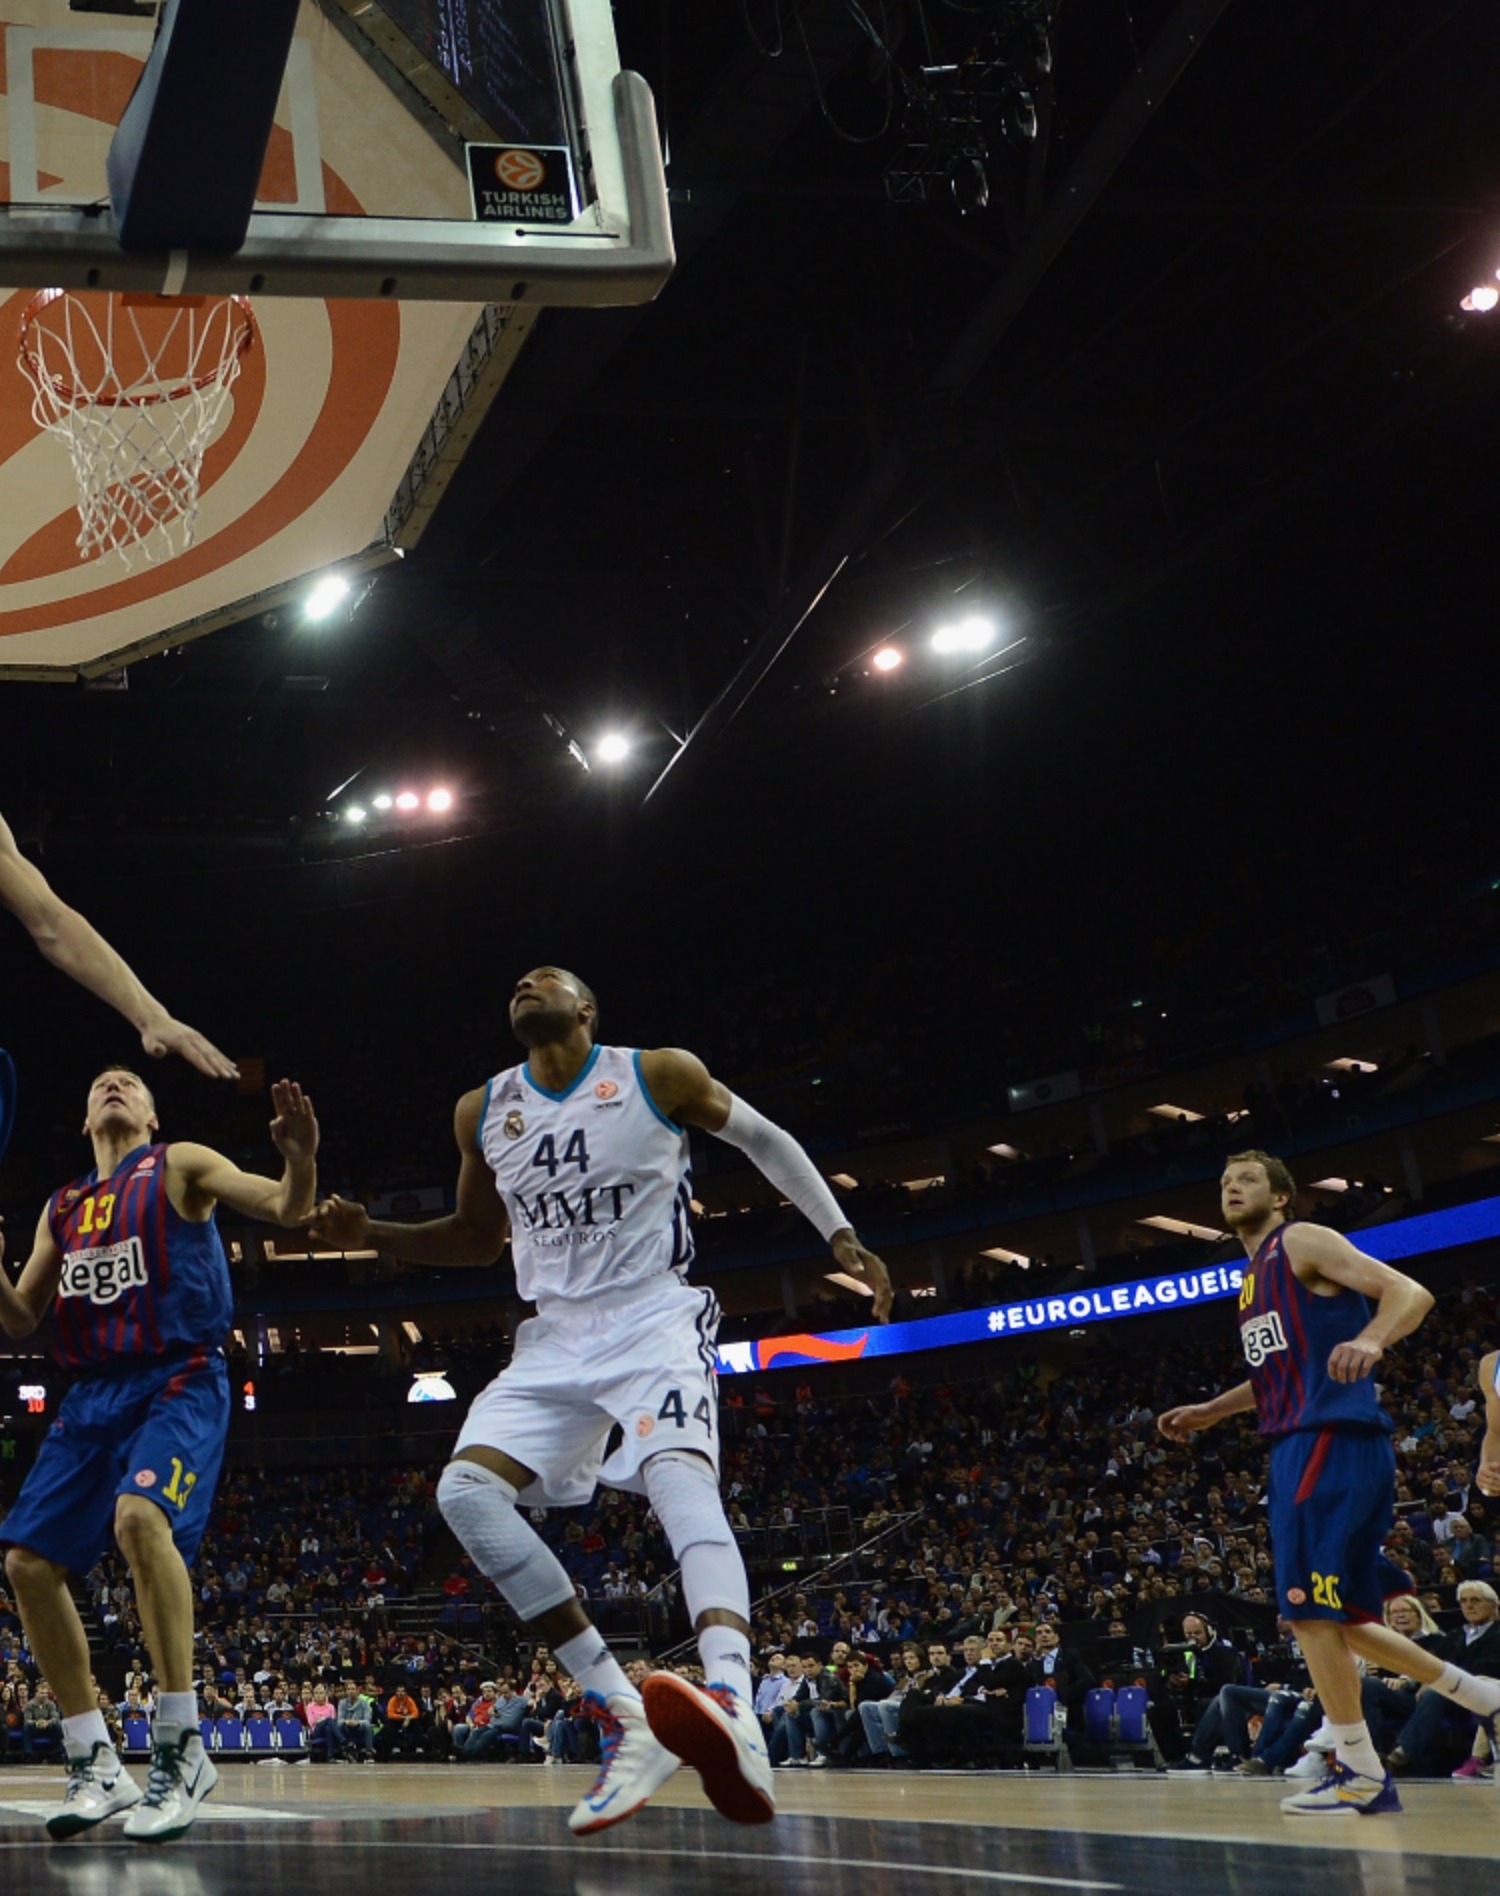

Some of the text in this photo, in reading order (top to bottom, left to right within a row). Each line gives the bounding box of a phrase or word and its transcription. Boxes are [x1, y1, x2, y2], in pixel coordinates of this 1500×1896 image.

[482, 191, 566, 206] TURKISH
[483, 204, 568, 220] AIRLINES
[533, 1128, 591, 1178] 44
[77, 1193, 116, 1235] 13
[513, 1183, 635, 1229] MMT
[534, 1226, 617, 1248] SEGUROS
[60, 1241, 144, 1299] Regal
[1248, 1315, 1284, 1363] gal
